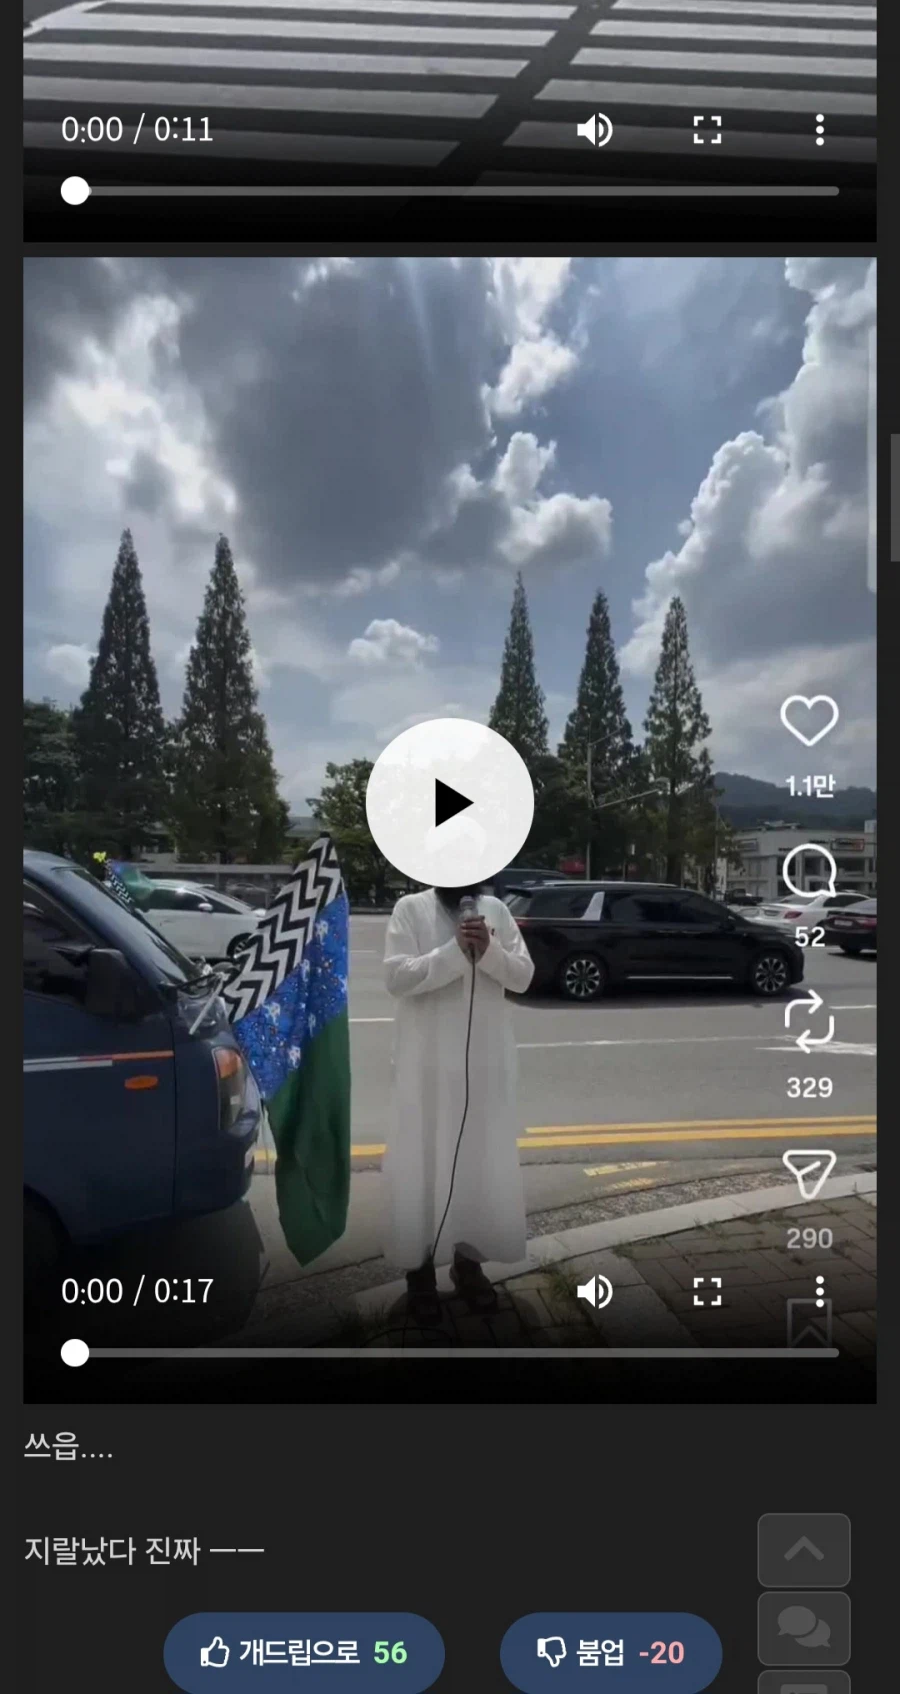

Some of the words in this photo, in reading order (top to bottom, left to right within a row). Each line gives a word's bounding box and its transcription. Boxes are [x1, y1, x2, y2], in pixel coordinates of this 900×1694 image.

[23, 1431, 113, 1461] 쓰읍....
[24, 1536, 137, 1566] 지랄났다
[145, 1536, 202, 1566] 진짜
[239, 1638, 361, 1667] 개드립으로
[373, 1640, 408, 1664] 56
[576, 1638, 624, 1667] 붐업
[639, 1640, 685, 1664] -20
